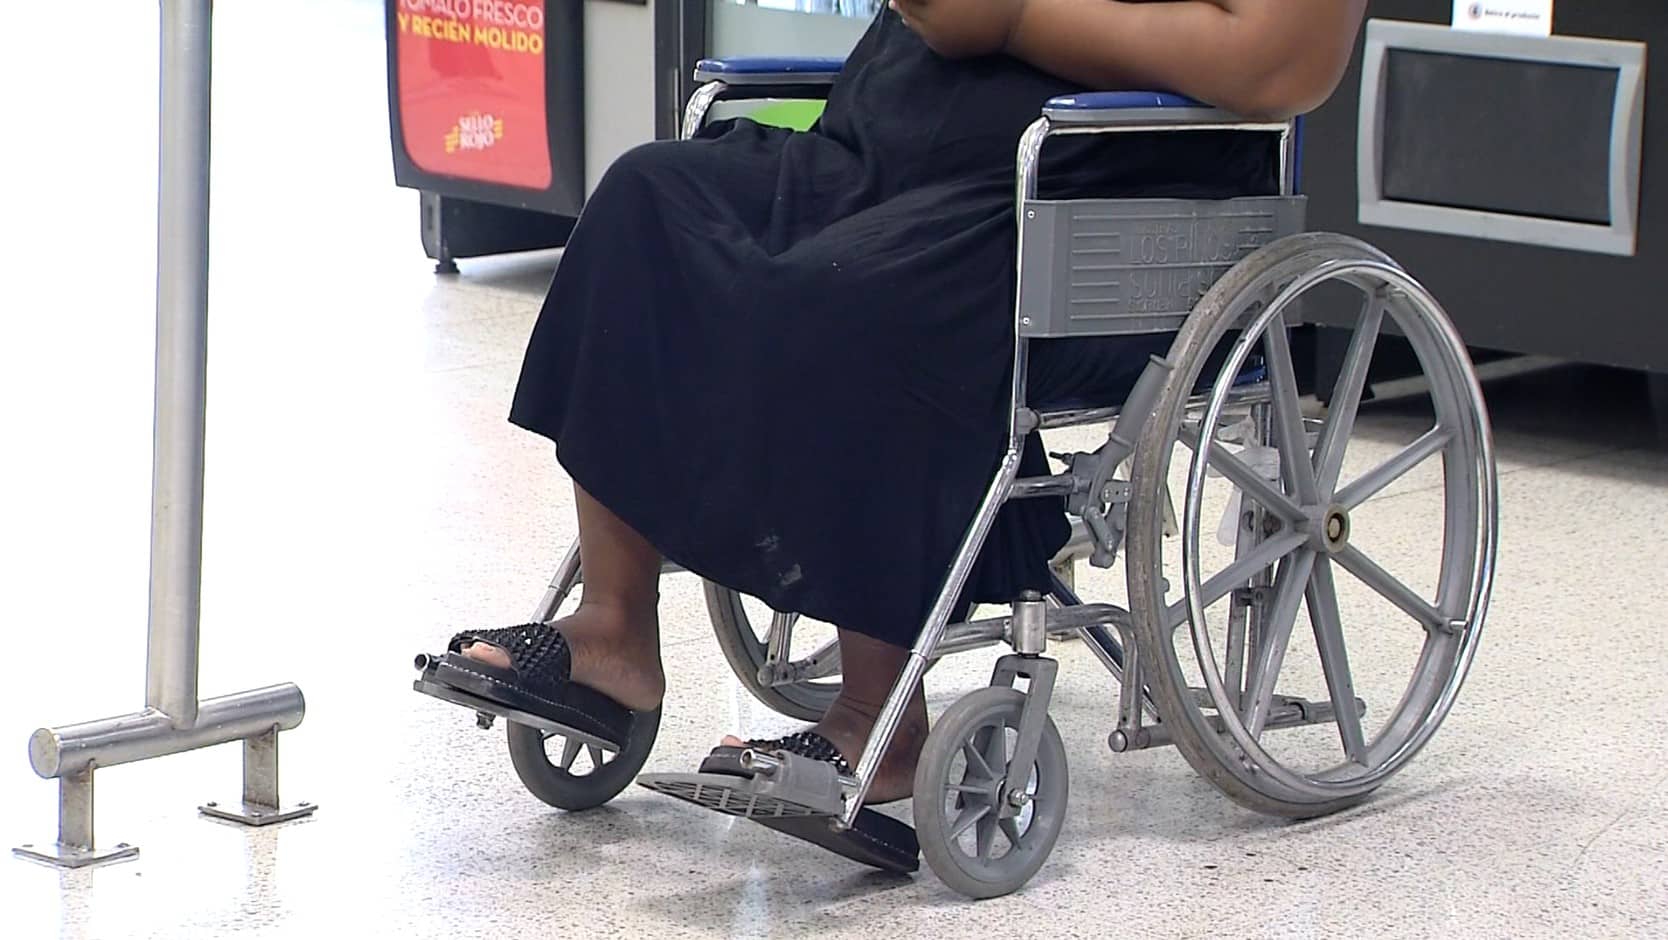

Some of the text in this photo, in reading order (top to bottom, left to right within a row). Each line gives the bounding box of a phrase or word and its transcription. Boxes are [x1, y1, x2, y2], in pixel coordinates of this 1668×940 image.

[397, 11, 544, 55] Y RECIÉN MOLIDO
[473, 0, 544, 30] FRESCO
